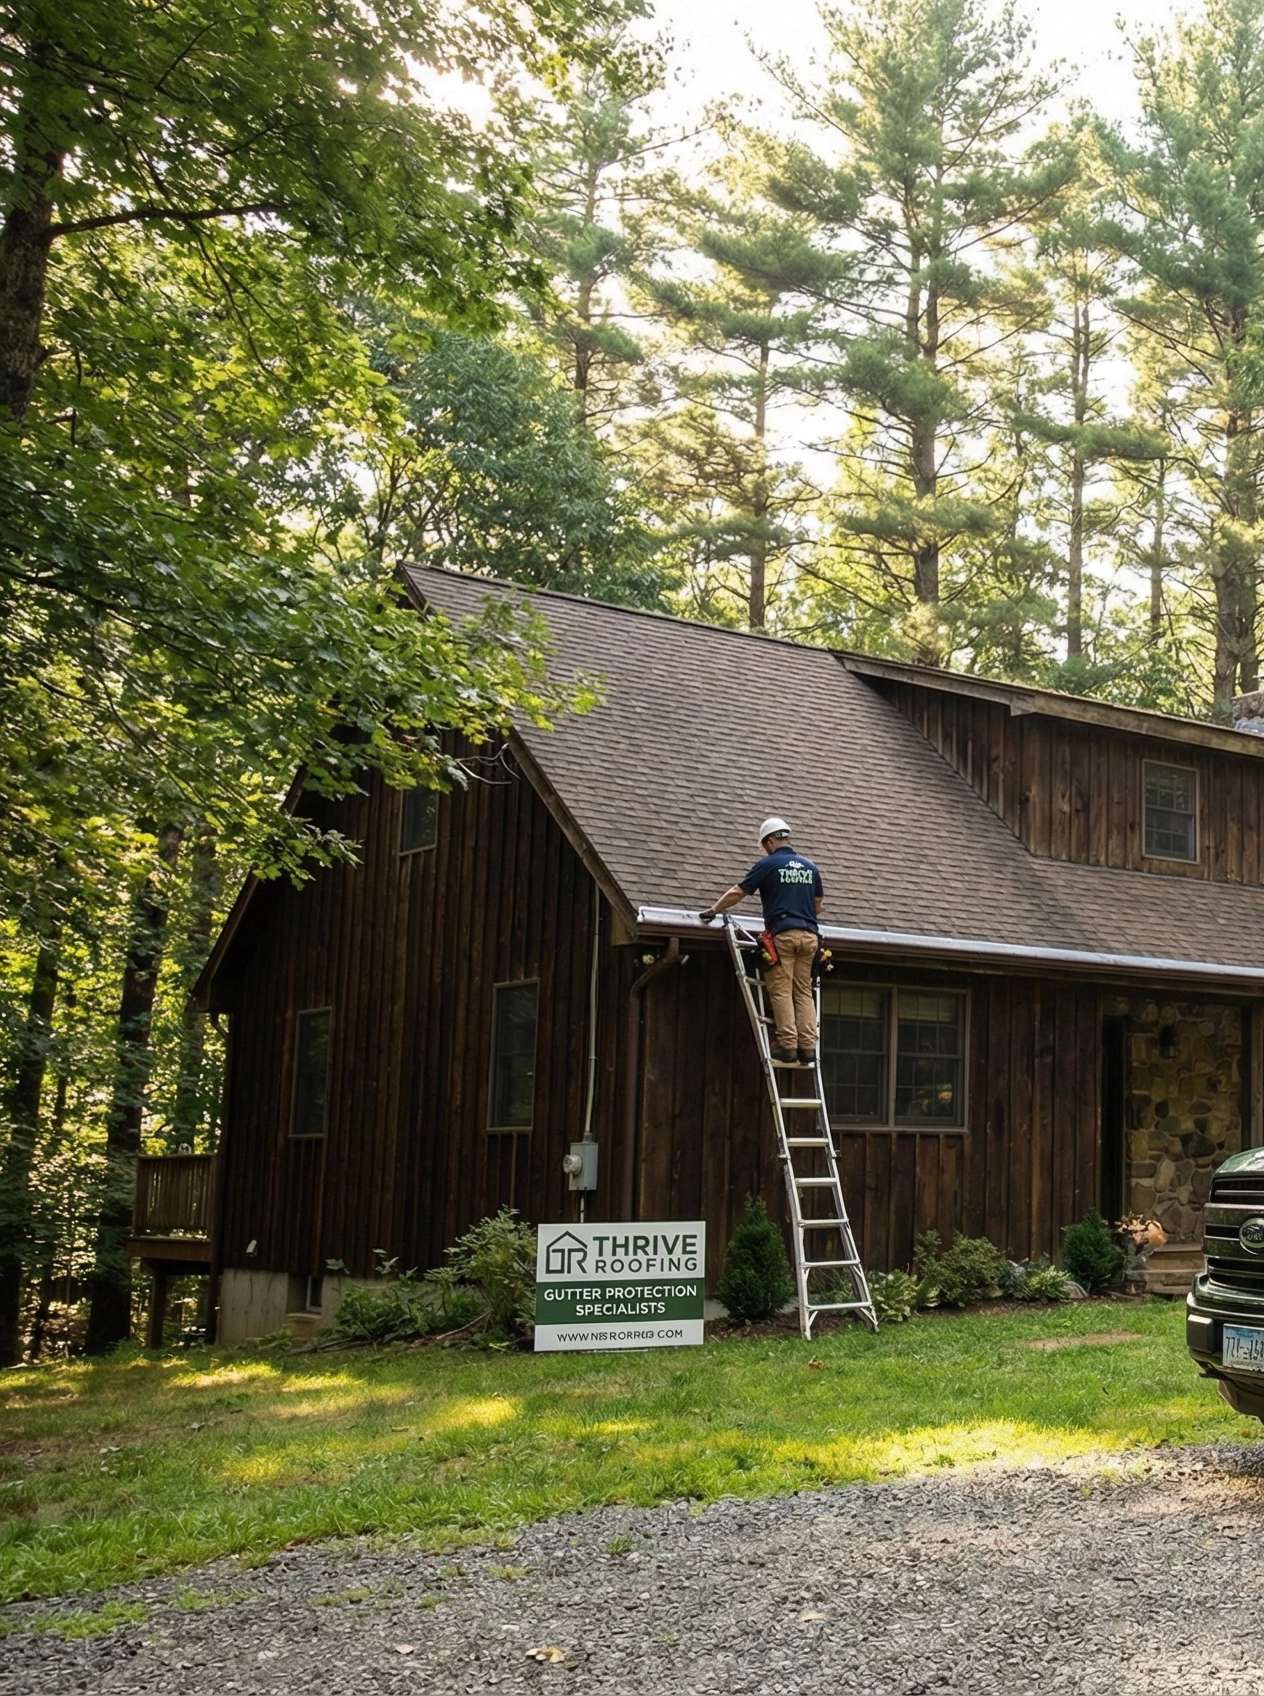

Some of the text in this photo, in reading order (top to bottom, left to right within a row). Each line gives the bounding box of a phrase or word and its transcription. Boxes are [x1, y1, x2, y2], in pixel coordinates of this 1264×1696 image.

[592, 1234, 698, 1257] THRIVE
[595, 1257, 698, 1274] ROOFING
[543, 1285, 697, 1301] GUTTER PROTECTION
[575, 1302, 666, 1316] SPECIALISTS
